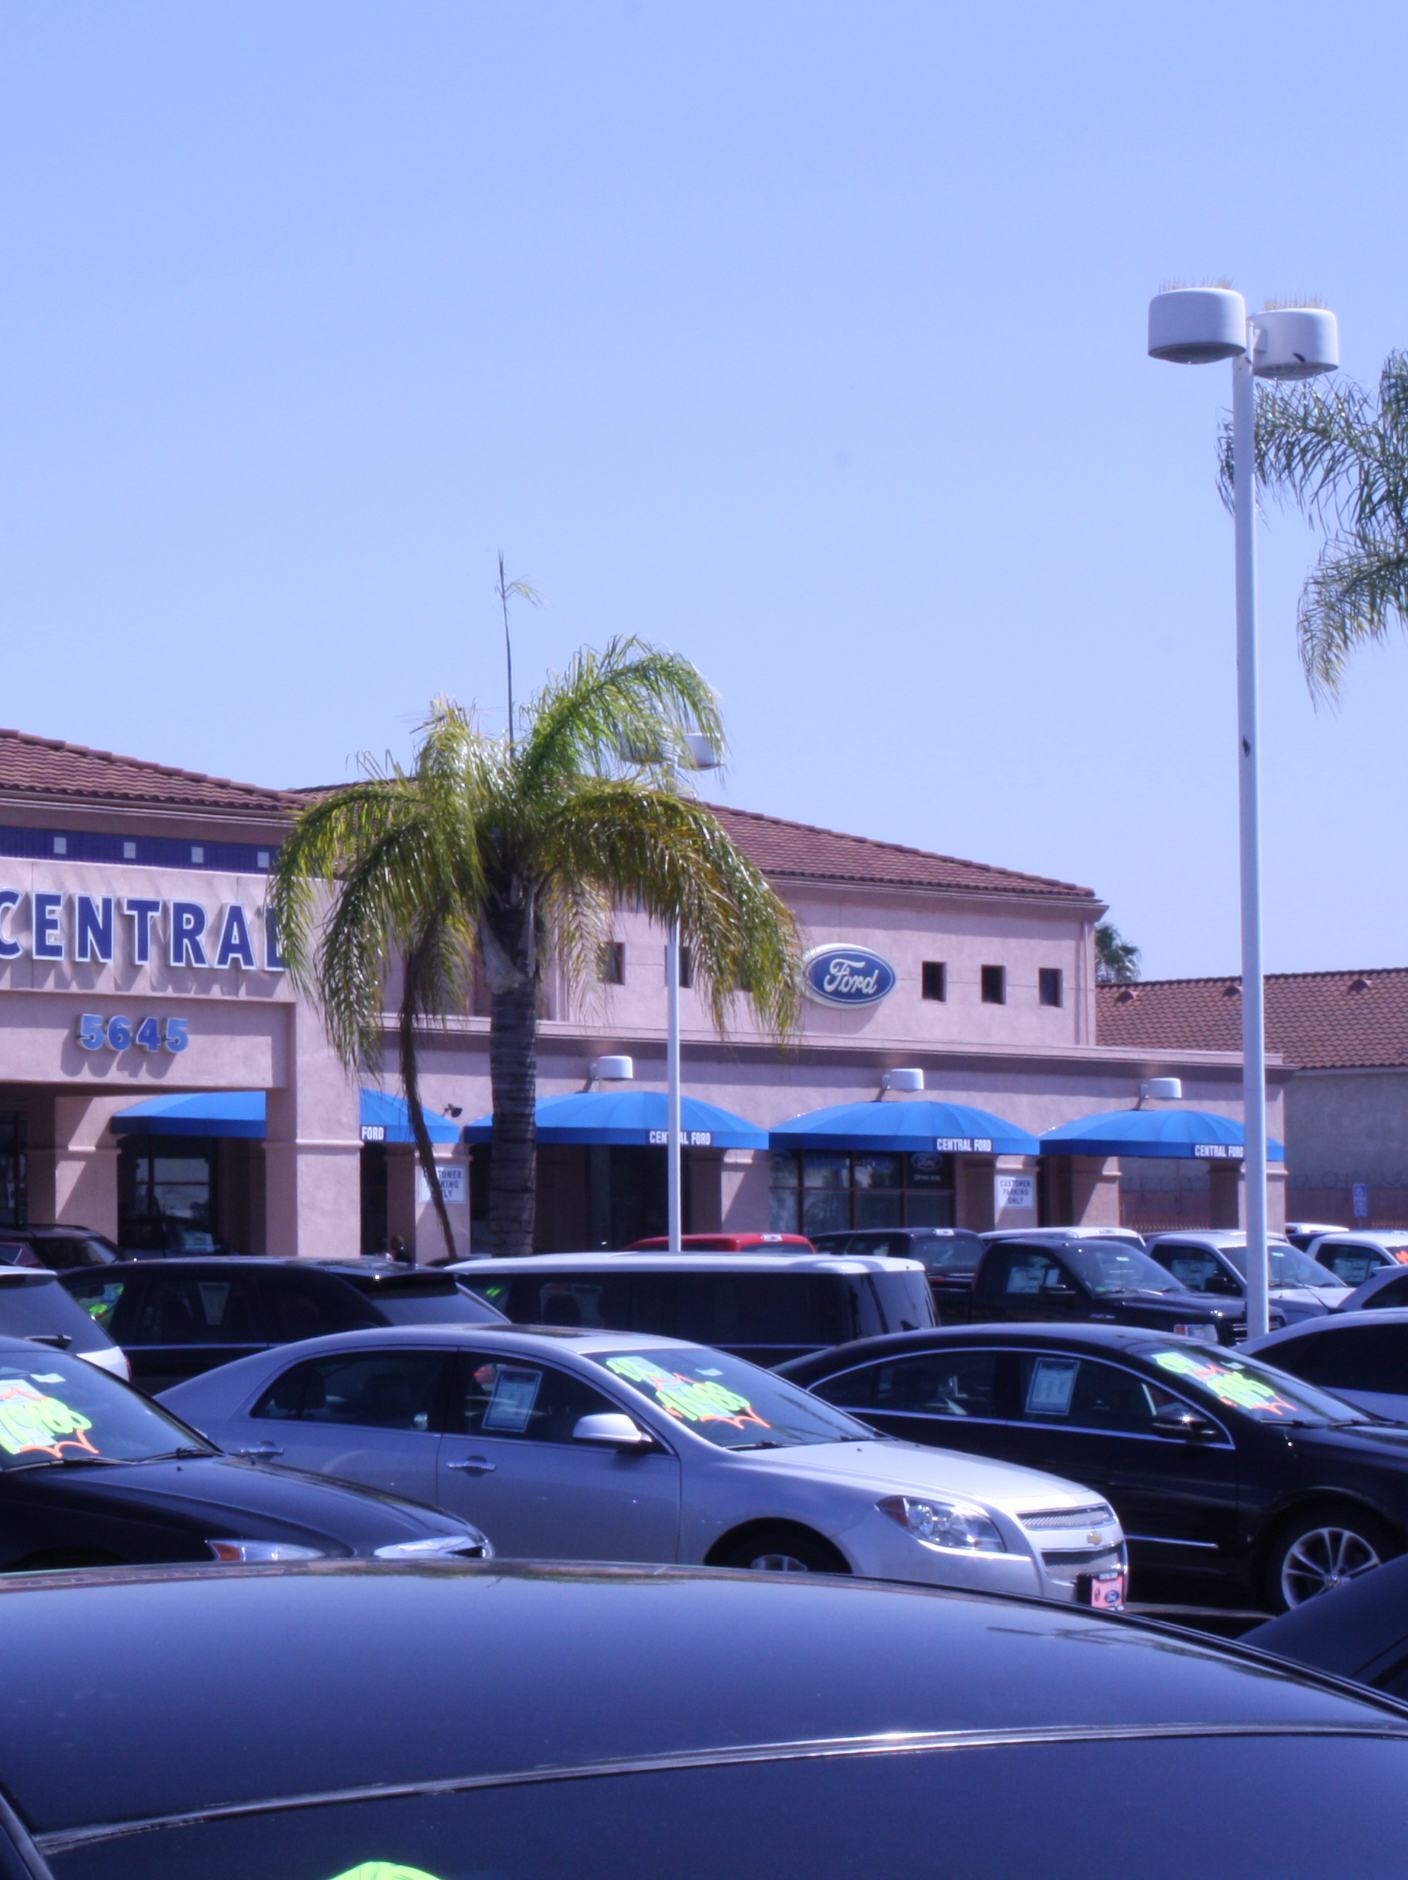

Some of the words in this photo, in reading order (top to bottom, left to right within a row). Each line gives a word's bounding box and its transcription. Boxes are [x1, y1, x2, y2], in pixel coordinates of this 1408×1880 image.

[823, 958, 879, 995] Ford
[79, 1013, 190, 1053] 5645
[361, 1126, 384, 1140] FORD
[649, 1131, 689, 1144] CENAL
[690, 1131, 711, 1145] FORD
[936, 1138, 972, 1151] CENTRAL
[973, 1139, 992, 1152] FORD
[1194, 1144, 1227, 1157] CENTRAL
[999, 1179, 1031, 1188] CUSTOMER
[1002, 1188, 1029, 1196] PARKING
[1007, 1197, 1023, 1205] ONLY
[605, 1357, 660, 1383] 12
